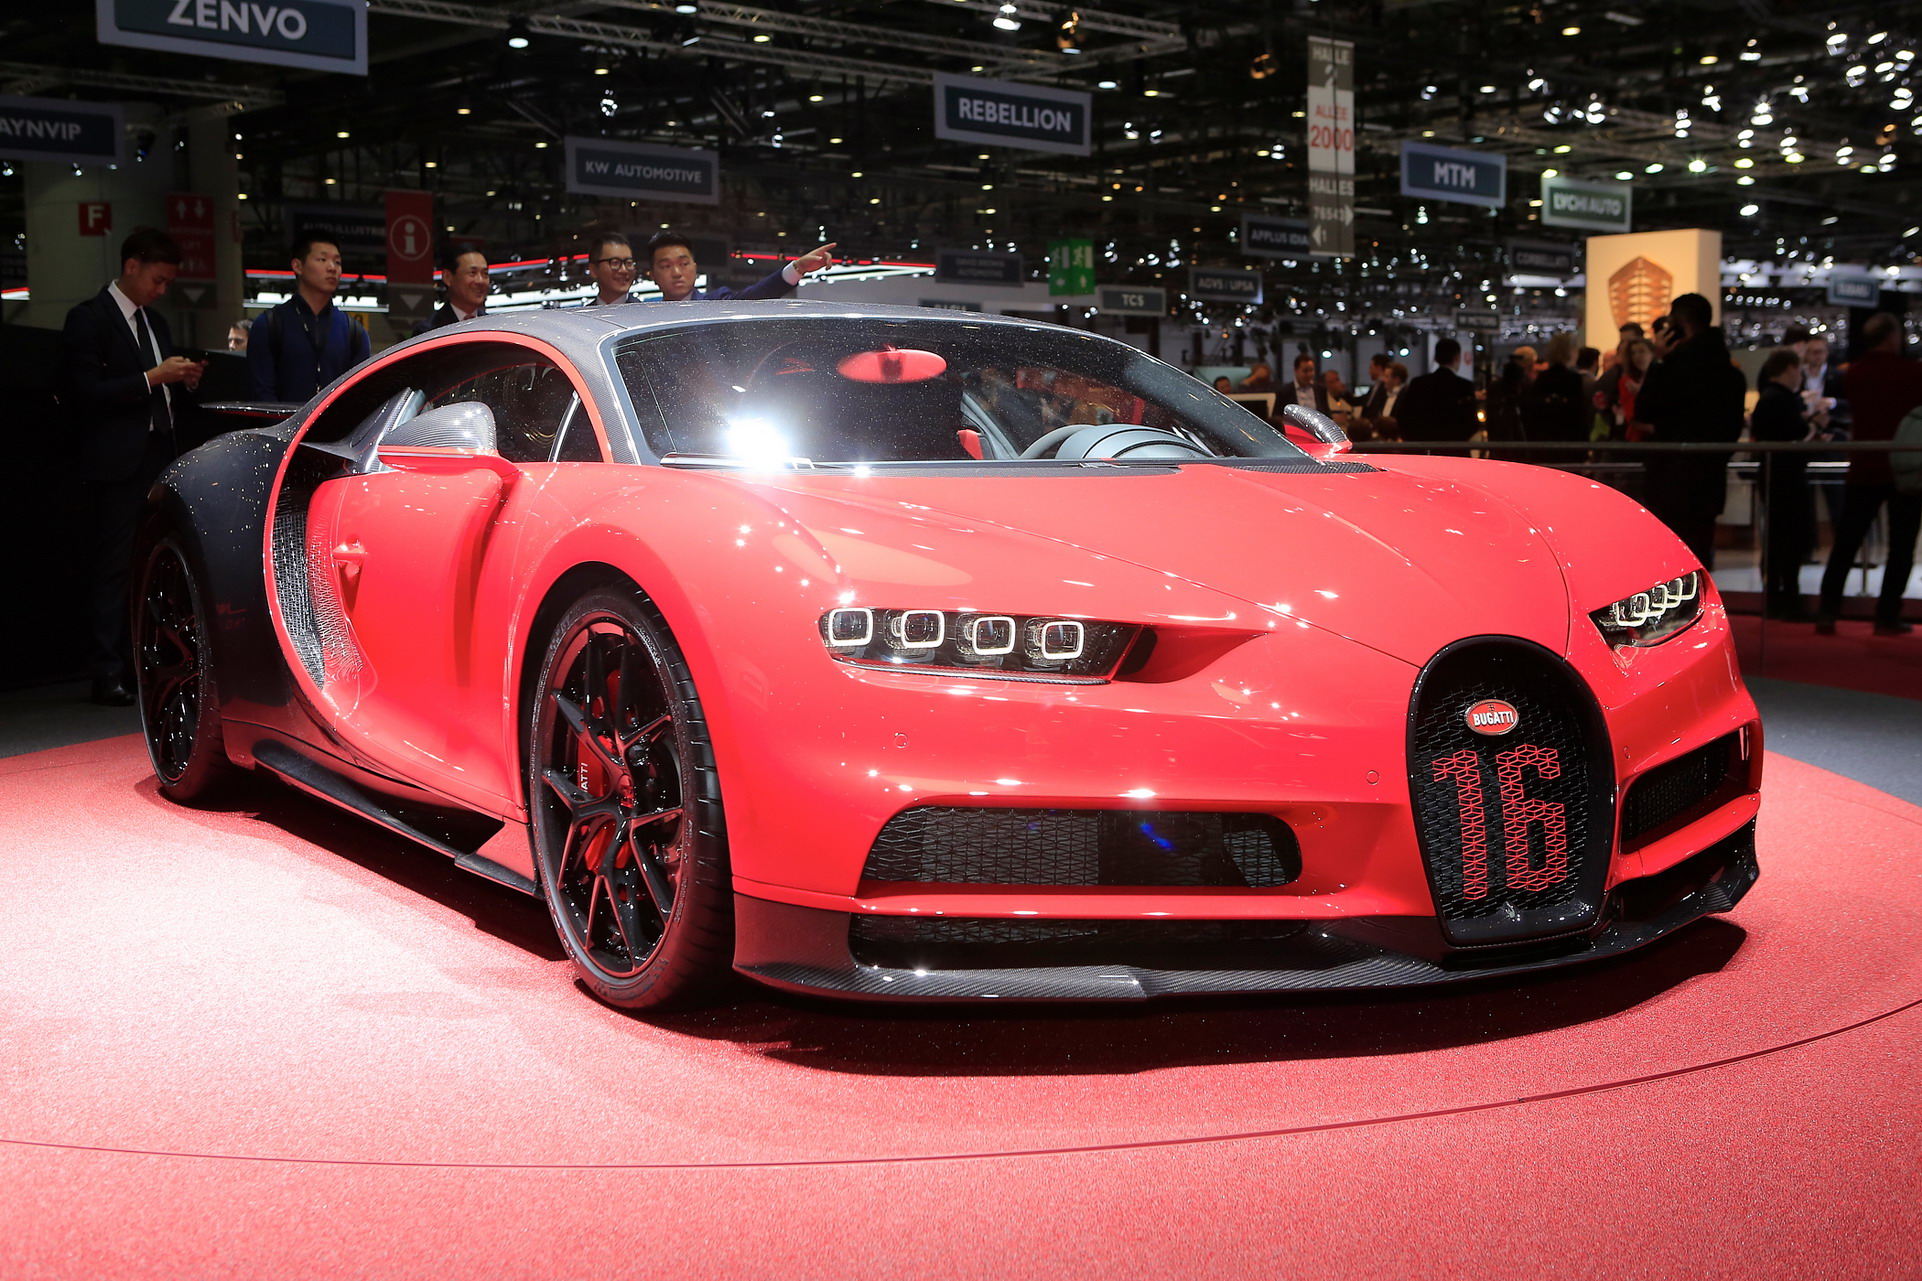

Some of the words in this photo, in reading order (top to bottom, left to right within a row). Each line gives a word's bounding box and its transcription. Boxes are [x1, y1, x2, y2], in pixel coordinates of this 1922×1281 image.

[167, 0, 308, 40] ZENVO
[957, 96, 1072, 133] REBELLION
[0, 116, 82, 141] AYNVIP
[1310, 125, 1354, 152] 2000
[585, 160, 610, 175] KW
[614, 163, 702, 184] AUTOMOTIVE
[1433, 160, 1475, 190] MTM
[87, 205, 105, 229] F
[1121, 294, 1144, 307] TCS
[1473, 711, 1514, 727] BUGATTI
[1432, 744, 1567, 900] 16
